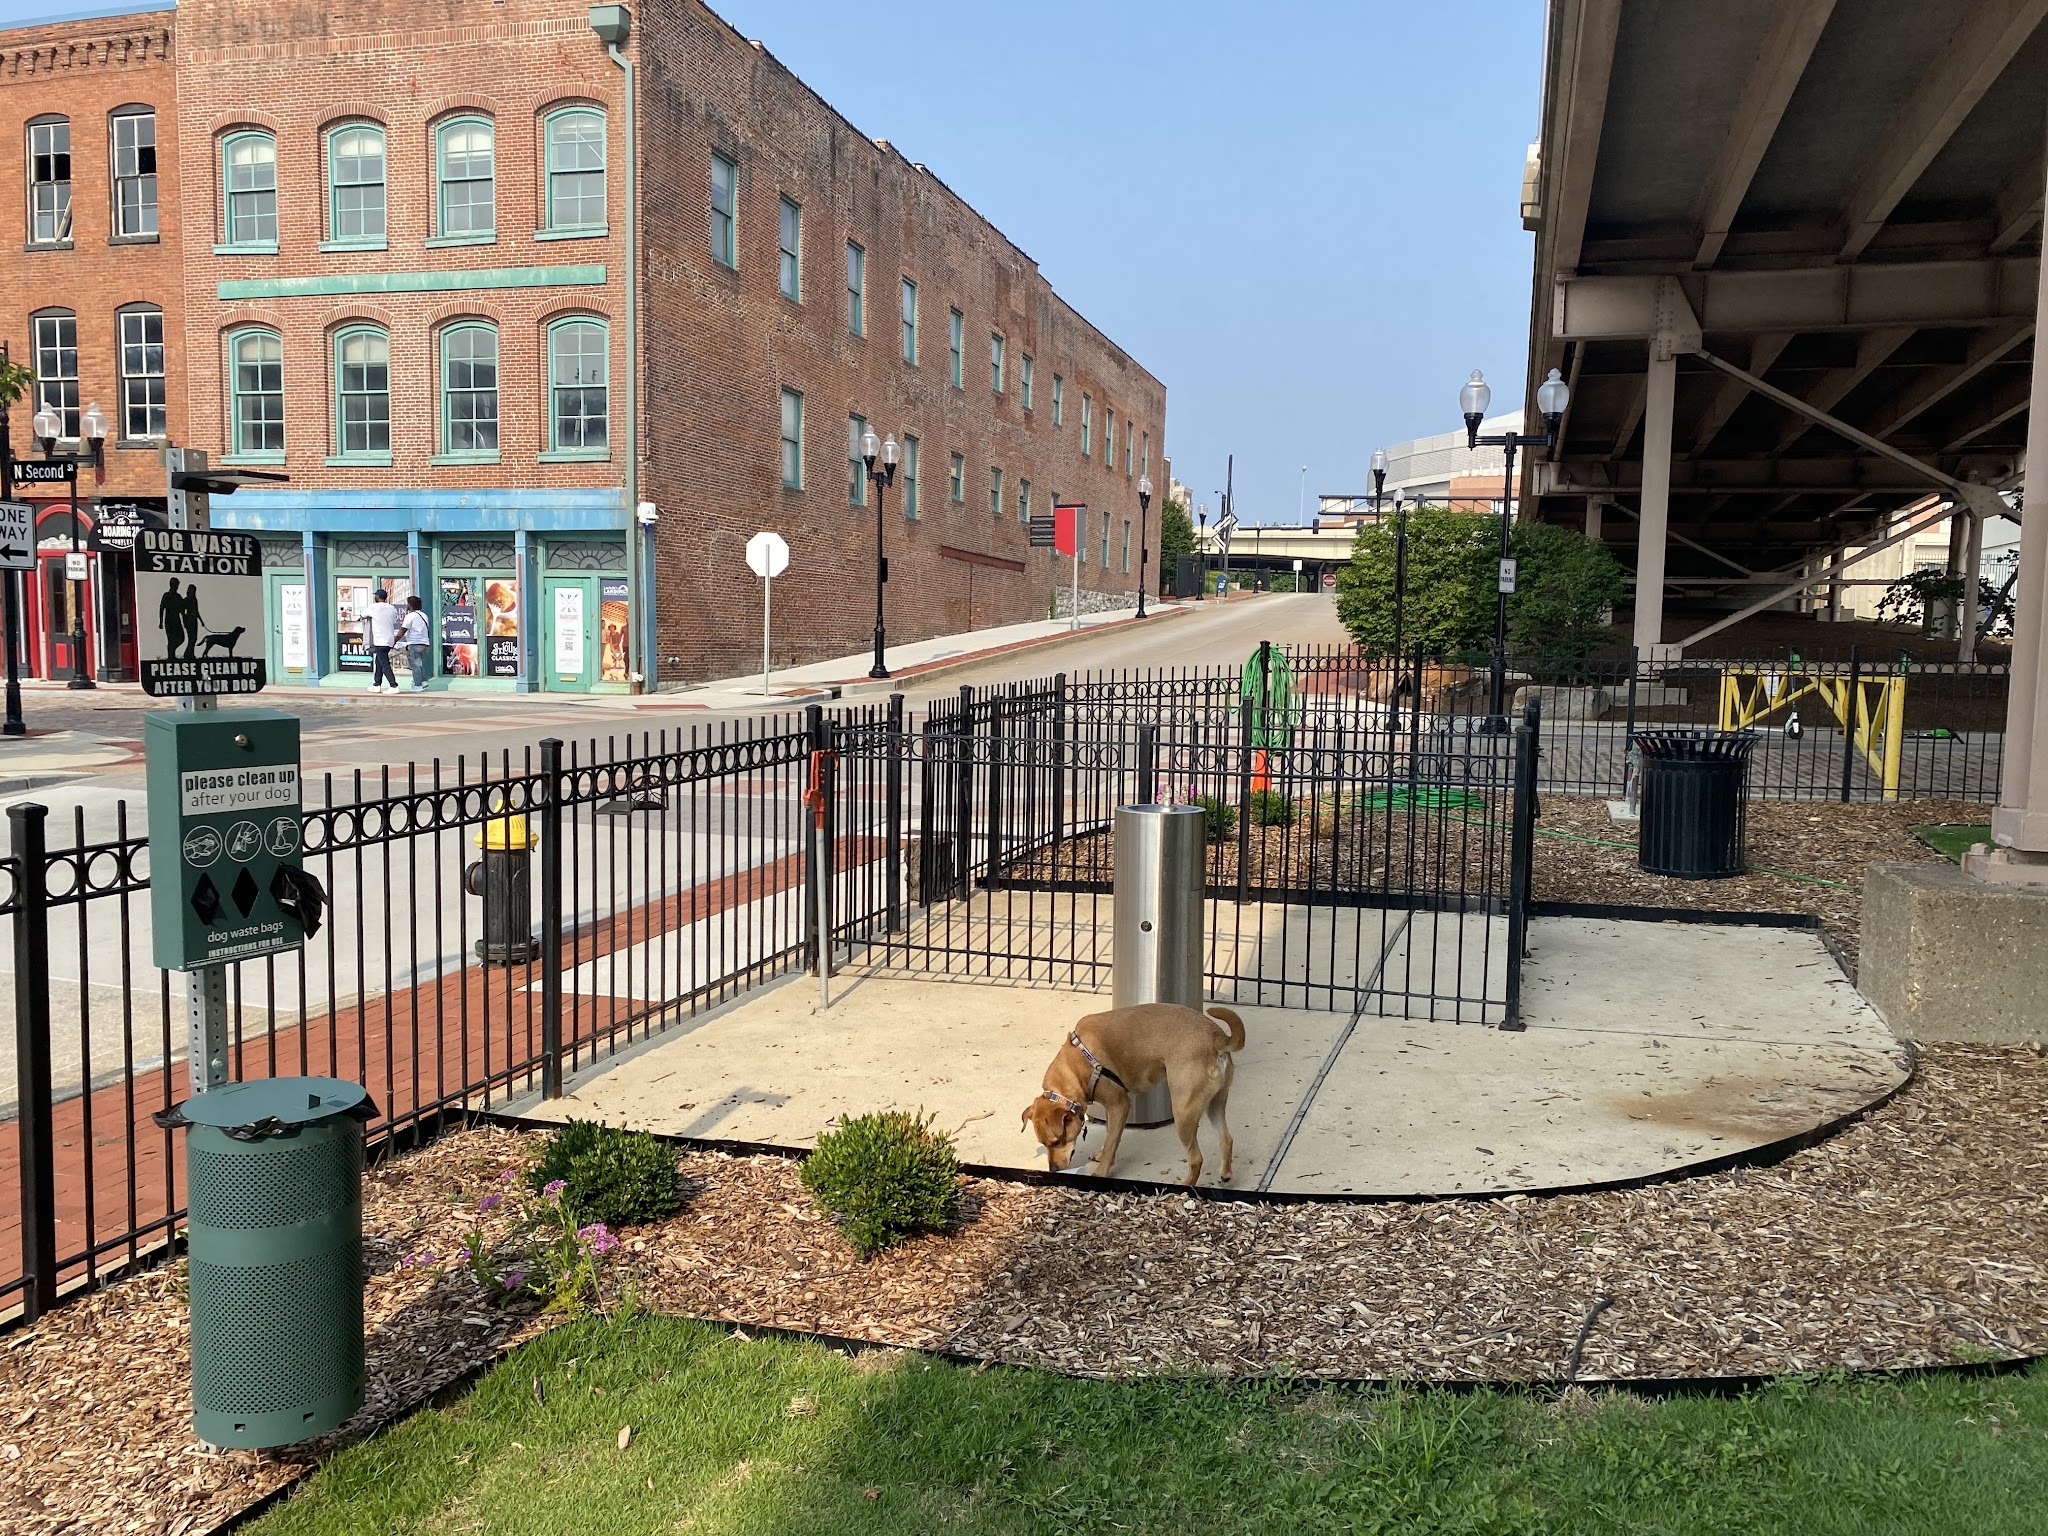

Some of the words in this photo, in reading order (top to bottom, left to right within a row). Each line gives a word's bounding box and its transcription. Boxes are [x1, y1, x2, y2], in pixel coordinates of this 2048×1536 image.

[14, 464, 22, 479] N
[26, 464, 64, 478] Second
[102, 525, 132, 538] ROARING
[144, 530, 184, 551] DOG
[190, 534, 252, 555] WASTE
[152, 555, 248, 574] STATION
[150, 663, 196, 676] PLEASE
[201, 662, 238, 675] CLEAN
[242, 662, 258, 674] UP
[154, 681, 192, 694] AFTER
[196, 680, 228, 693] YOUR
[232, 679, 256, 692] DOG
[185, 775, 234, 792] please
[238, 771, 275, 786] clean
[279, 770, 294, 784] up
[192, 792, 225, 806] after
[229, 790, 260, 806] your
[265, 786, 290, 801] dog
[208, 932, 228, 942] dog
[230, 926, 259, 939] waste
[260, 922, 284, 933] bags
[208, 942, 257, 958] INSTRUCTIONS
[258, 939, 270, 948] FOR
[272, 936, 284, 946] USE
